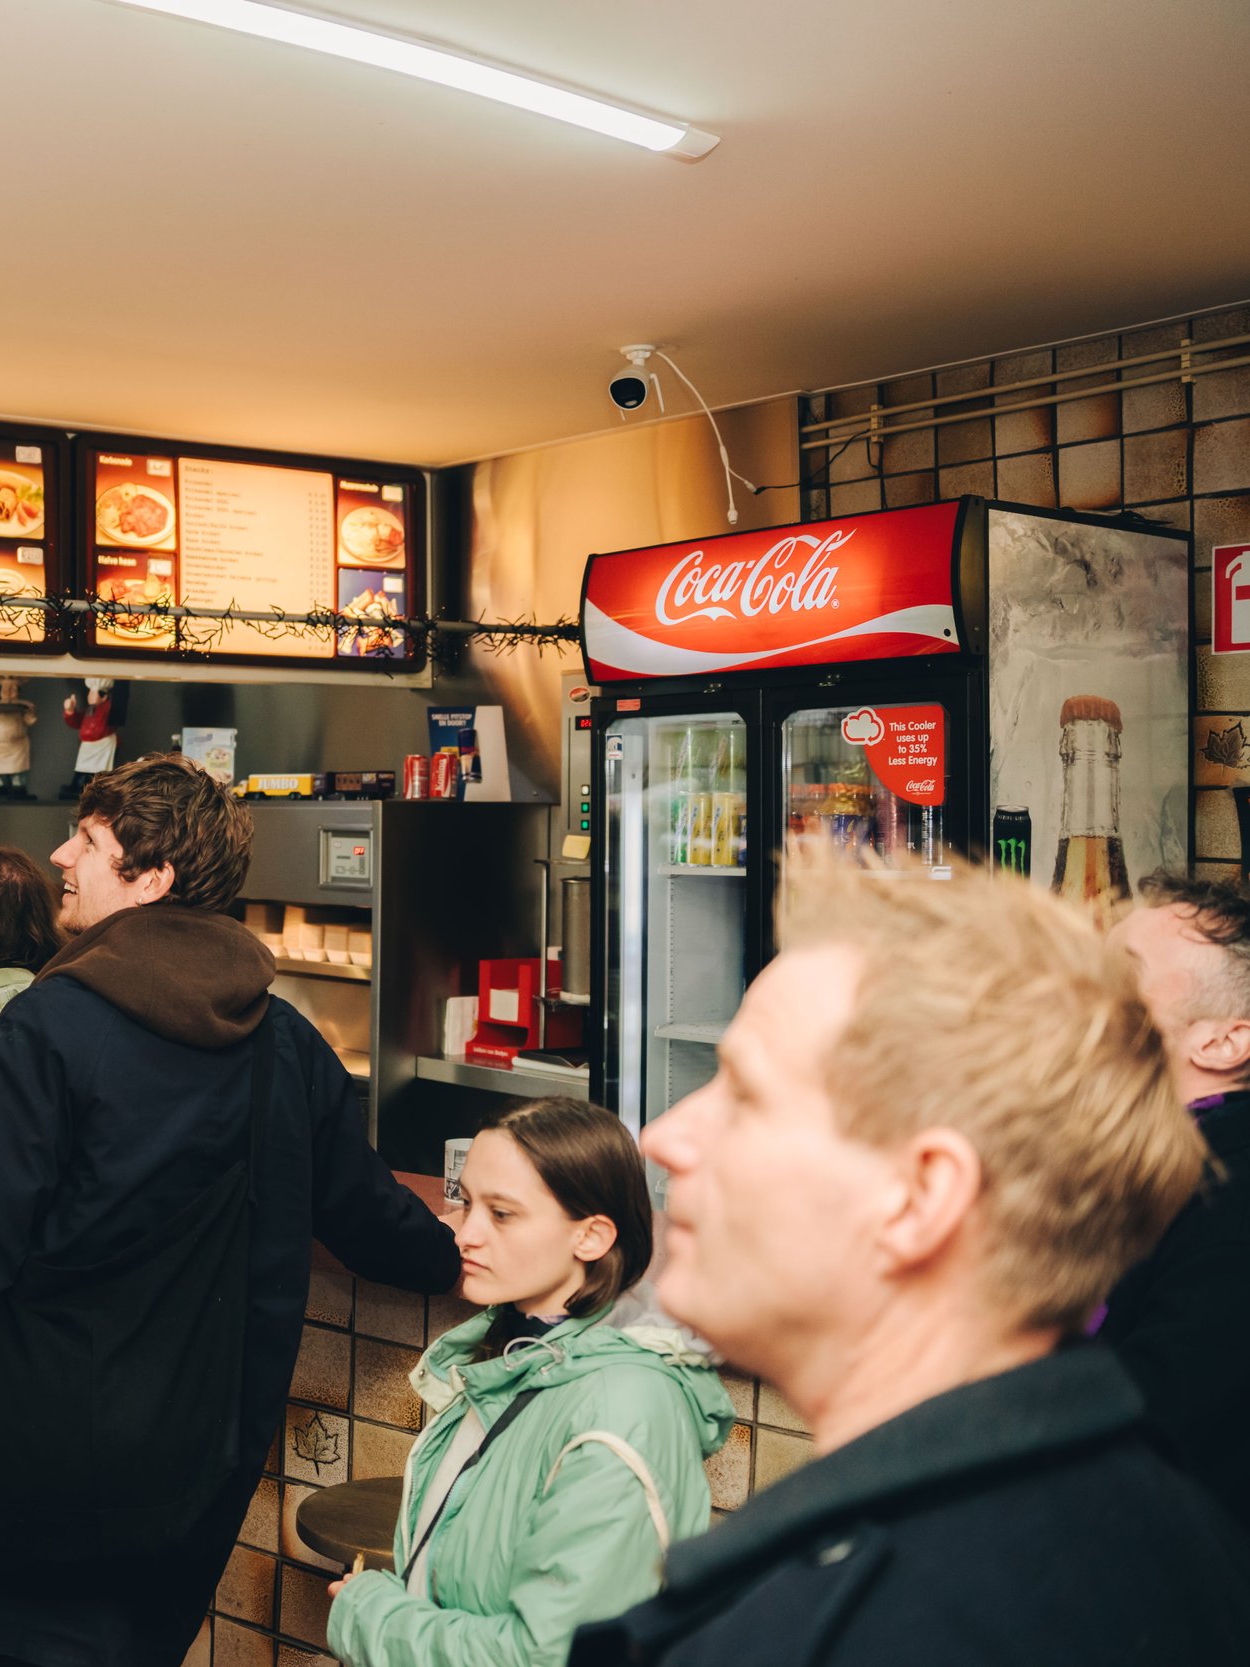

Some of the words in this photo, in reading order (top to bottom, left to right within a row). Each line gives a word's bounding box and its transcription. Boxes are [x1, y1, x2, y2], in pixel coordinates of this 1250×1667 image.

[655, 527, 857, 626] Coca-Cola
[889, 721, 906, 732] This
[908, 720, 937, 731] Cooler
[896, 734, 916, 743] uses
[917, 733, 929, 743] up
[897, 745, 907, 754] to
[909, 743, 927, 753] 35%
[888, 756, 906, 766] Less
[908, 755, 938, 767] Energy
[256, 778, 299, 791] JUMBO
[906, 779, 936, 792] Coca-Cola
